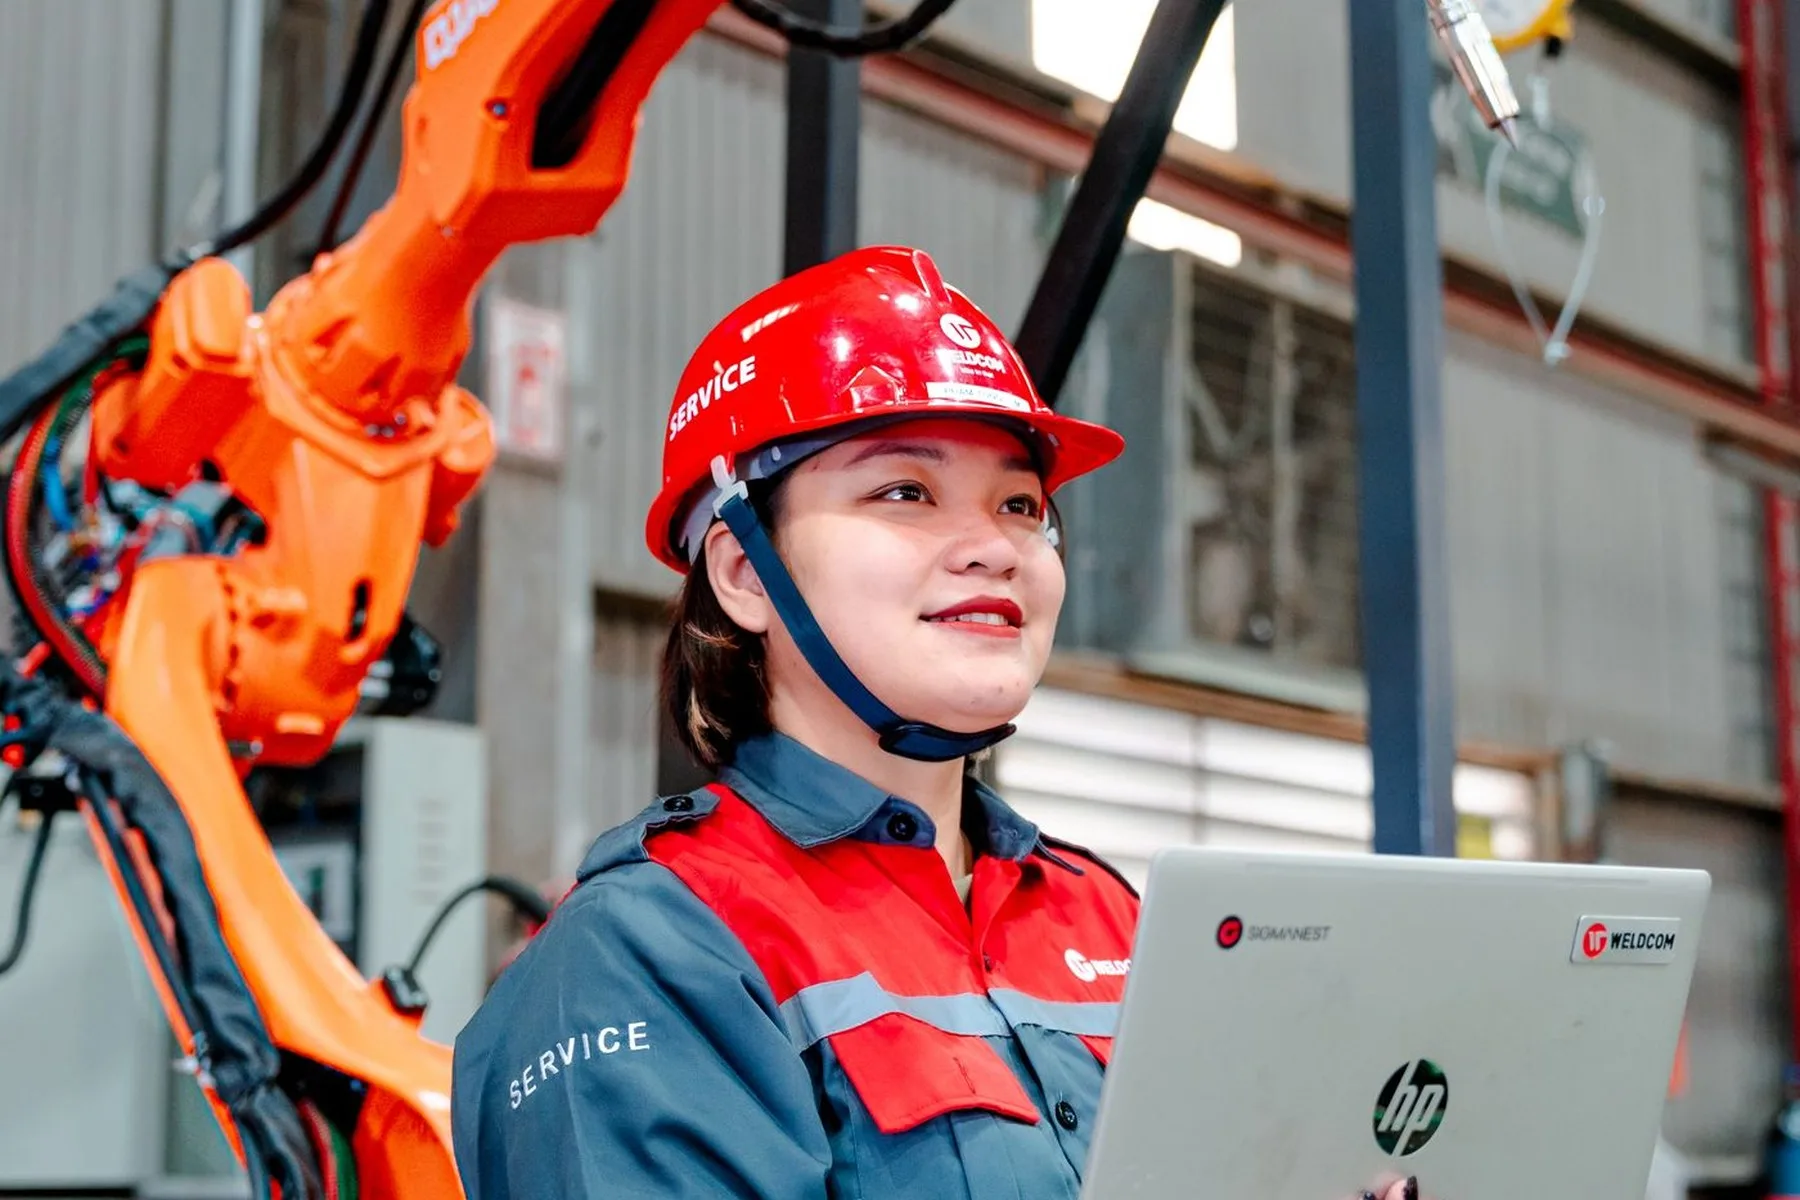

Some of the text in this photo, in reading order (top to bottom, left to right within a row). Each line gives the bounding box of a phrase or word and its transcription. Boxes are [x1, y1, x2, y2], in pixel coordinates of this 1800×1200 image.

[669, 355, 756, 441] SERVICE
[936, 349, 1007, 375] ELDCOM
[1610, 931, 1676, 950] WELDCOM
[509, 1021, 650, 1109] SERVICE
[1375, 1058, 1447, 1157] hp
